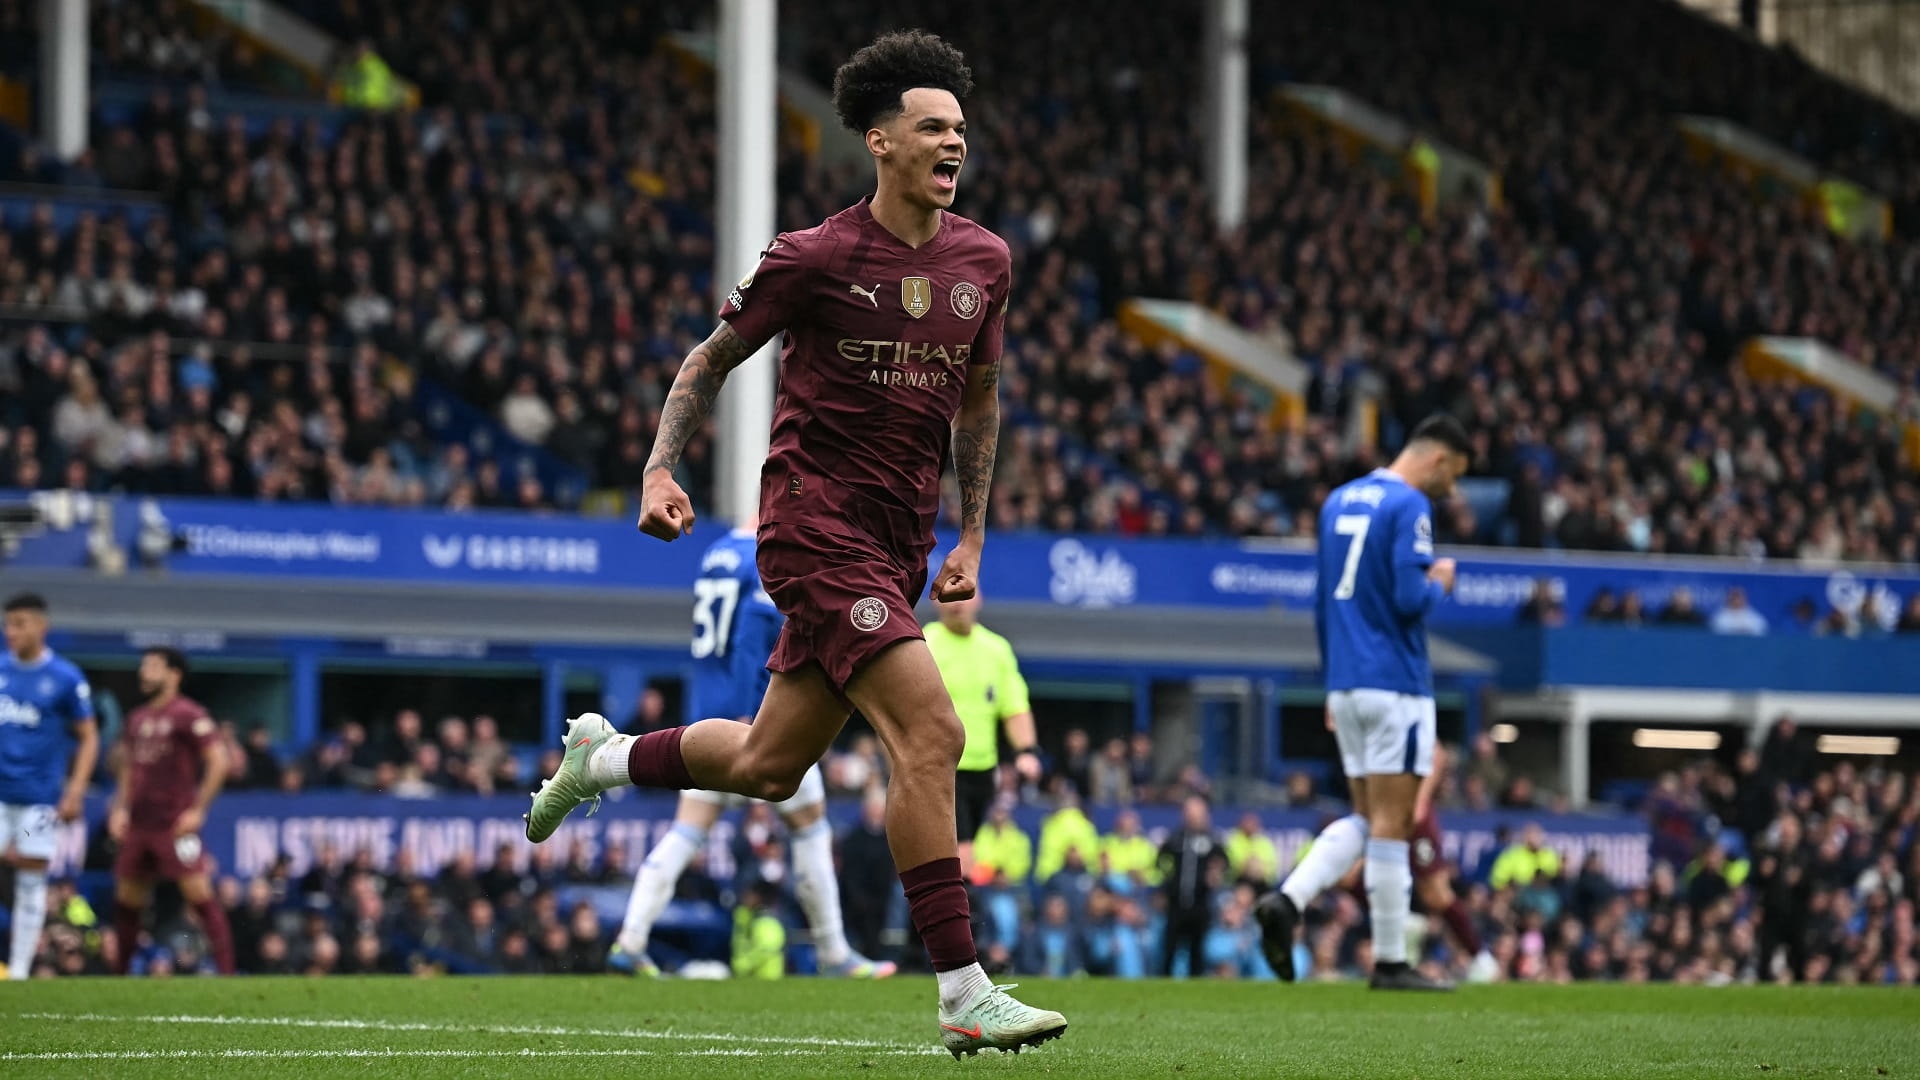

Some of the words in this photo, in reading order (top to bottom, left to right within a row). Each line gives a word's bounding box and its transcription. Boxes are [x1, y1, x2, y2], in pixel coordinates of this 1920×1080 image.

[868, 369, 949, 387] AIRWAYS
[1334, 514, 1371, 600] 7
[691, 578, 740, 659] 37
[234, 817, 279, 878] IN
